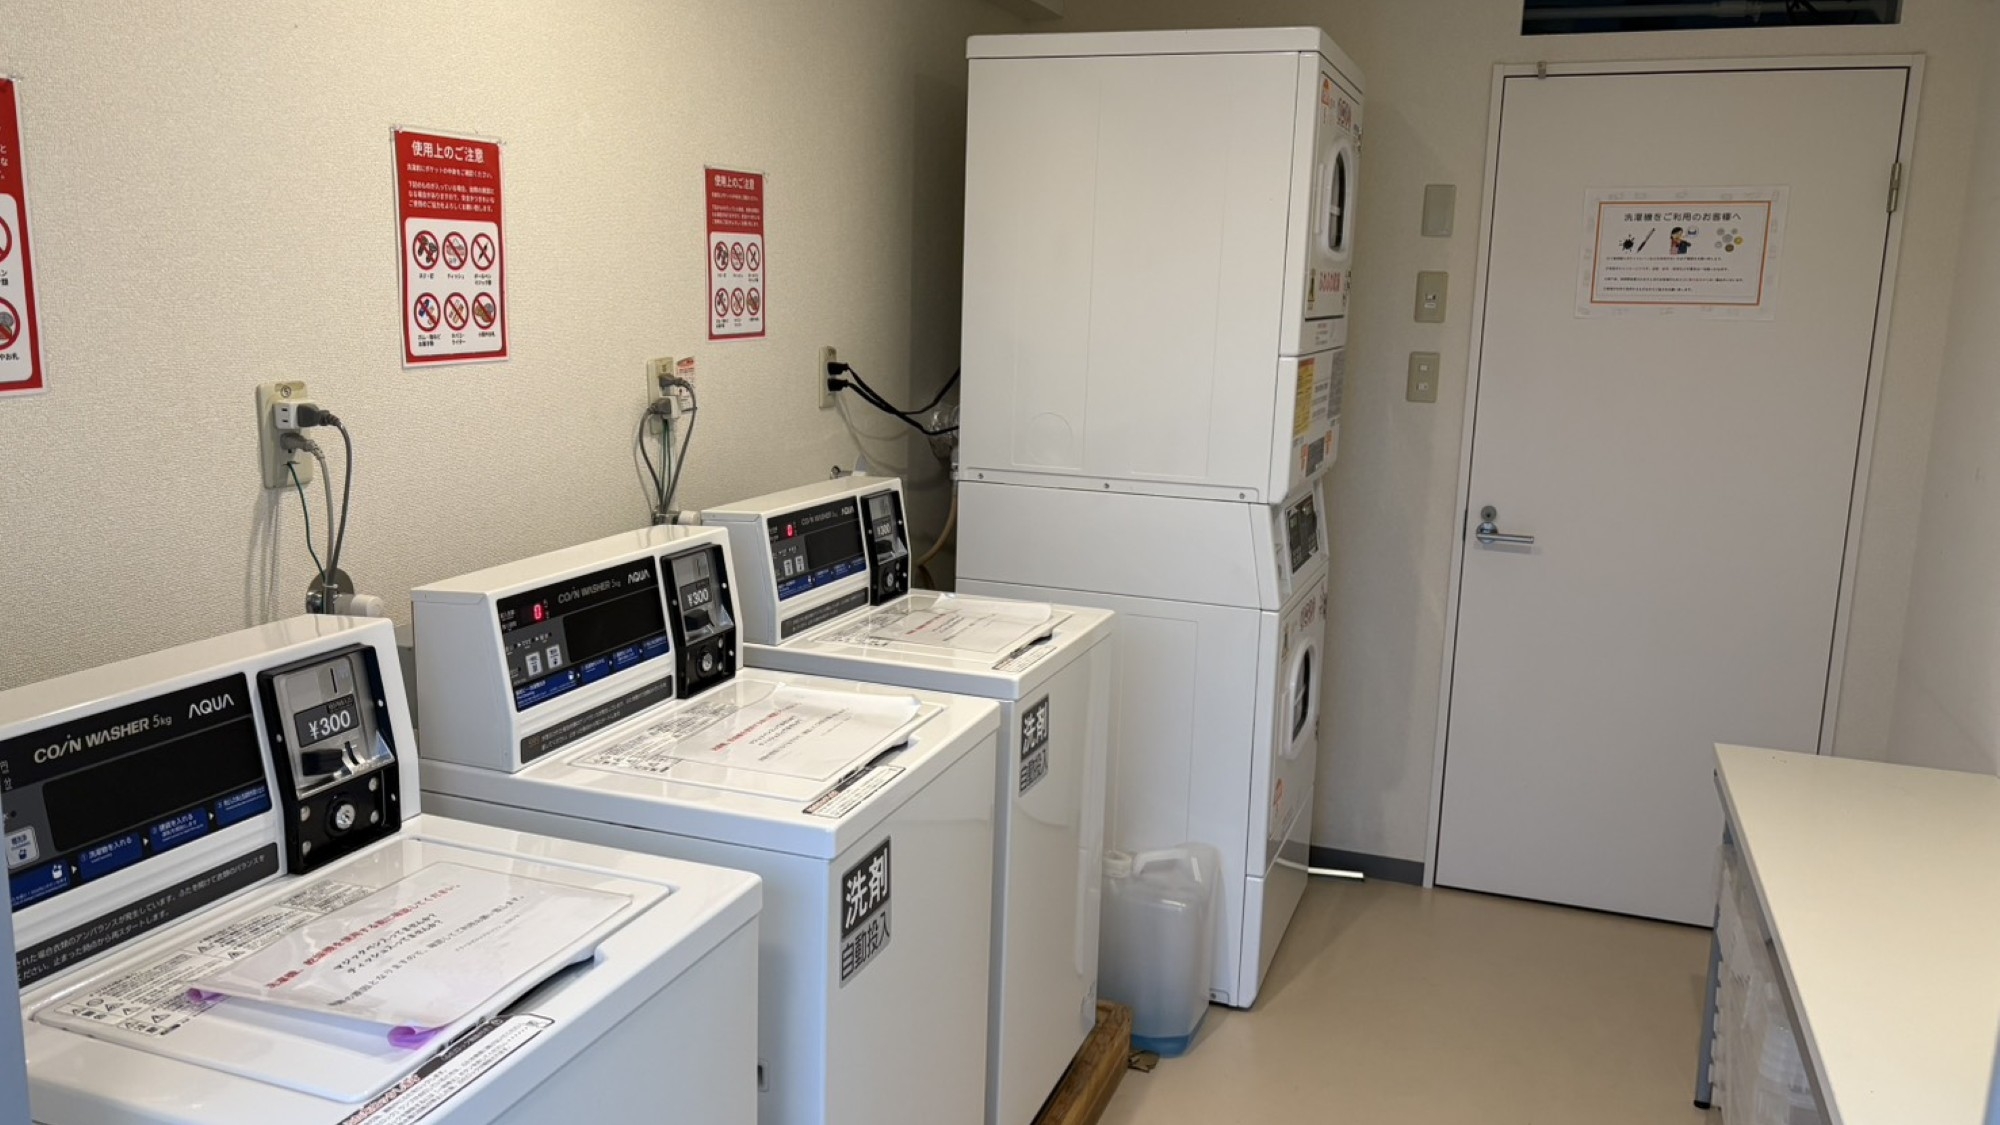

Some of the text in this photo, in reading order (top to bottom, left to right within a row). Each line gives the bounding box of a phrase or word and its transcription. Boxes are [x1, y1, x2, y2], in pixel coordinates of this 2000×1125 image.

[411, 140, 484, 163] 使用上のご注意
[1624, 212, 1742, 222] 洗濯機をご利用のお客様へ
[627, 569, 651, 585] AQUA
[687, 588, 709, 607] ¥300
[188, 693, 235, 719] AQUA
[85, 717, 150, 748] WASHER
[153, 713, 173, 729] 5kg
[309, 710, 350, 740] ¥300
[1022, 701, 1047, 754] 洗剤
[845, 847, 888, 929] 洗剤
[841, 911, 890, 981] 自動投入
